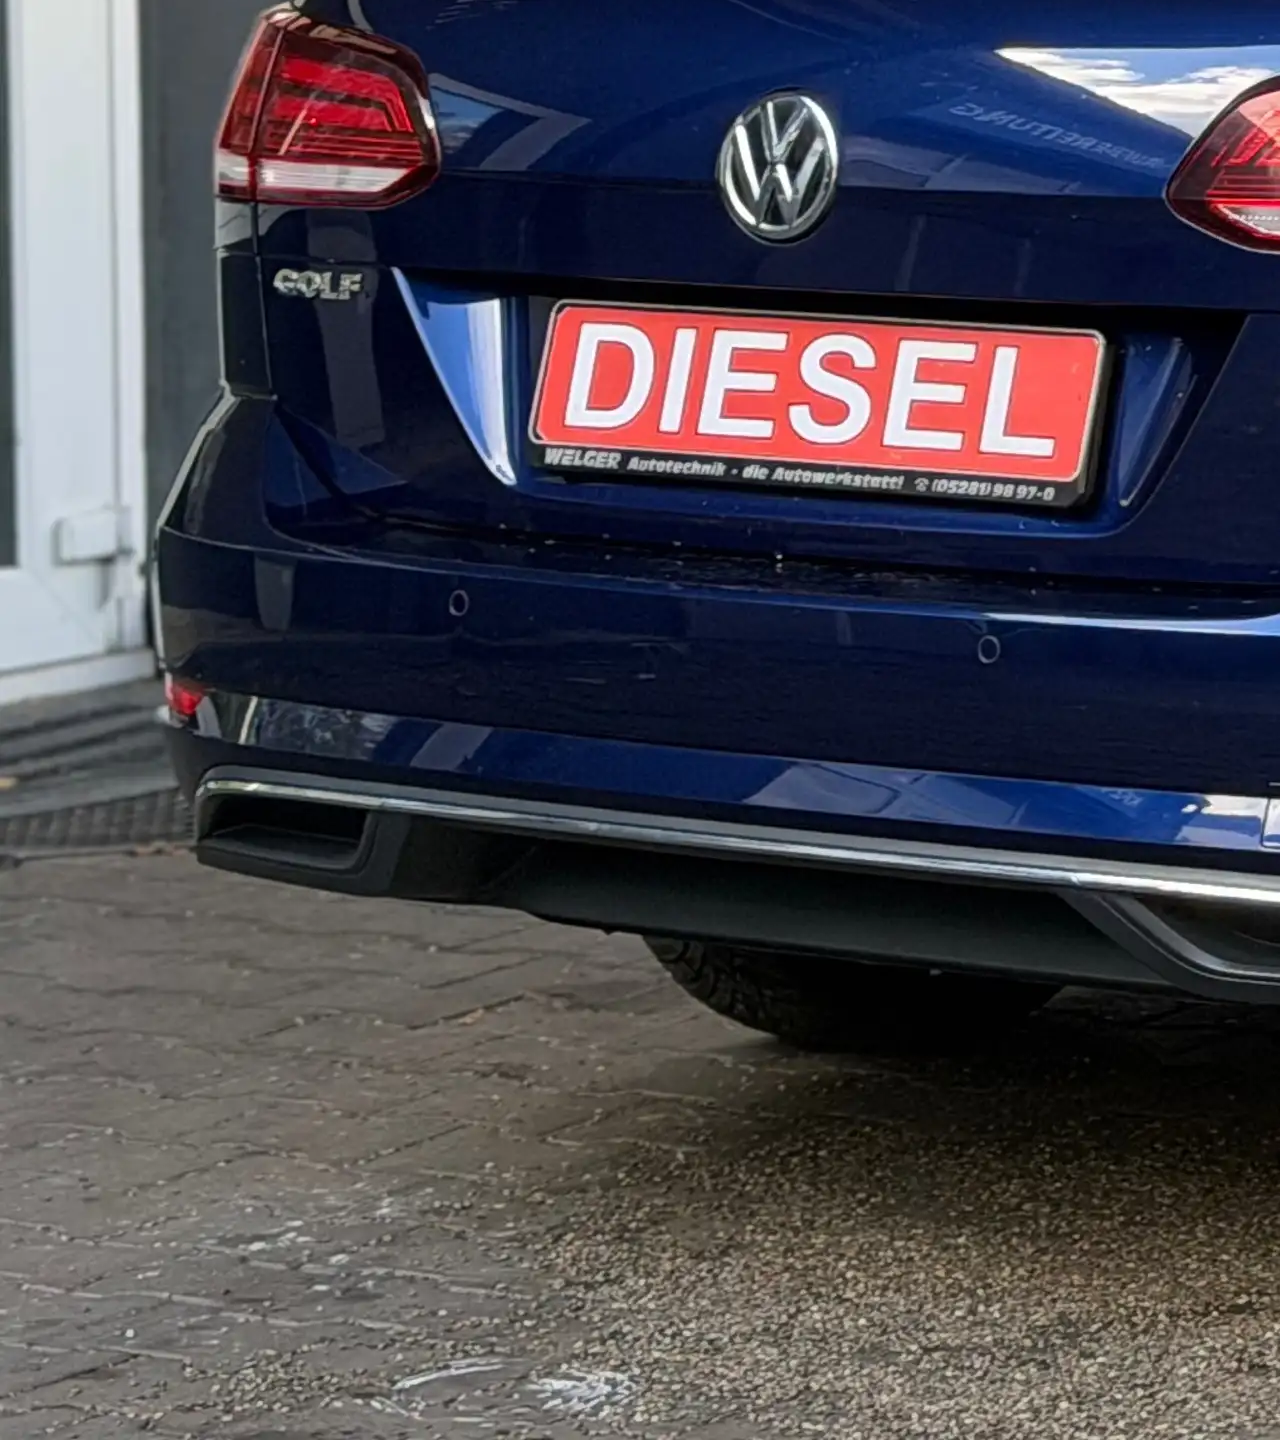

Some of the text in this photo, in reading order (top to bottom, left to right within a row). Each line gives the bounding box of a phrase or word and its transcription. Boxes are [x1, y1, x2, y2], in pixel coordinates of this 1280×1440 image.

[273, 268, 363, 300] GOLF
[563, 320, 1056, 458] DIESEL
[543, 447, 622, 470] WELGER
[626, 456, 726, 477] Autotechnik
[741, 463, 769, 480] die
